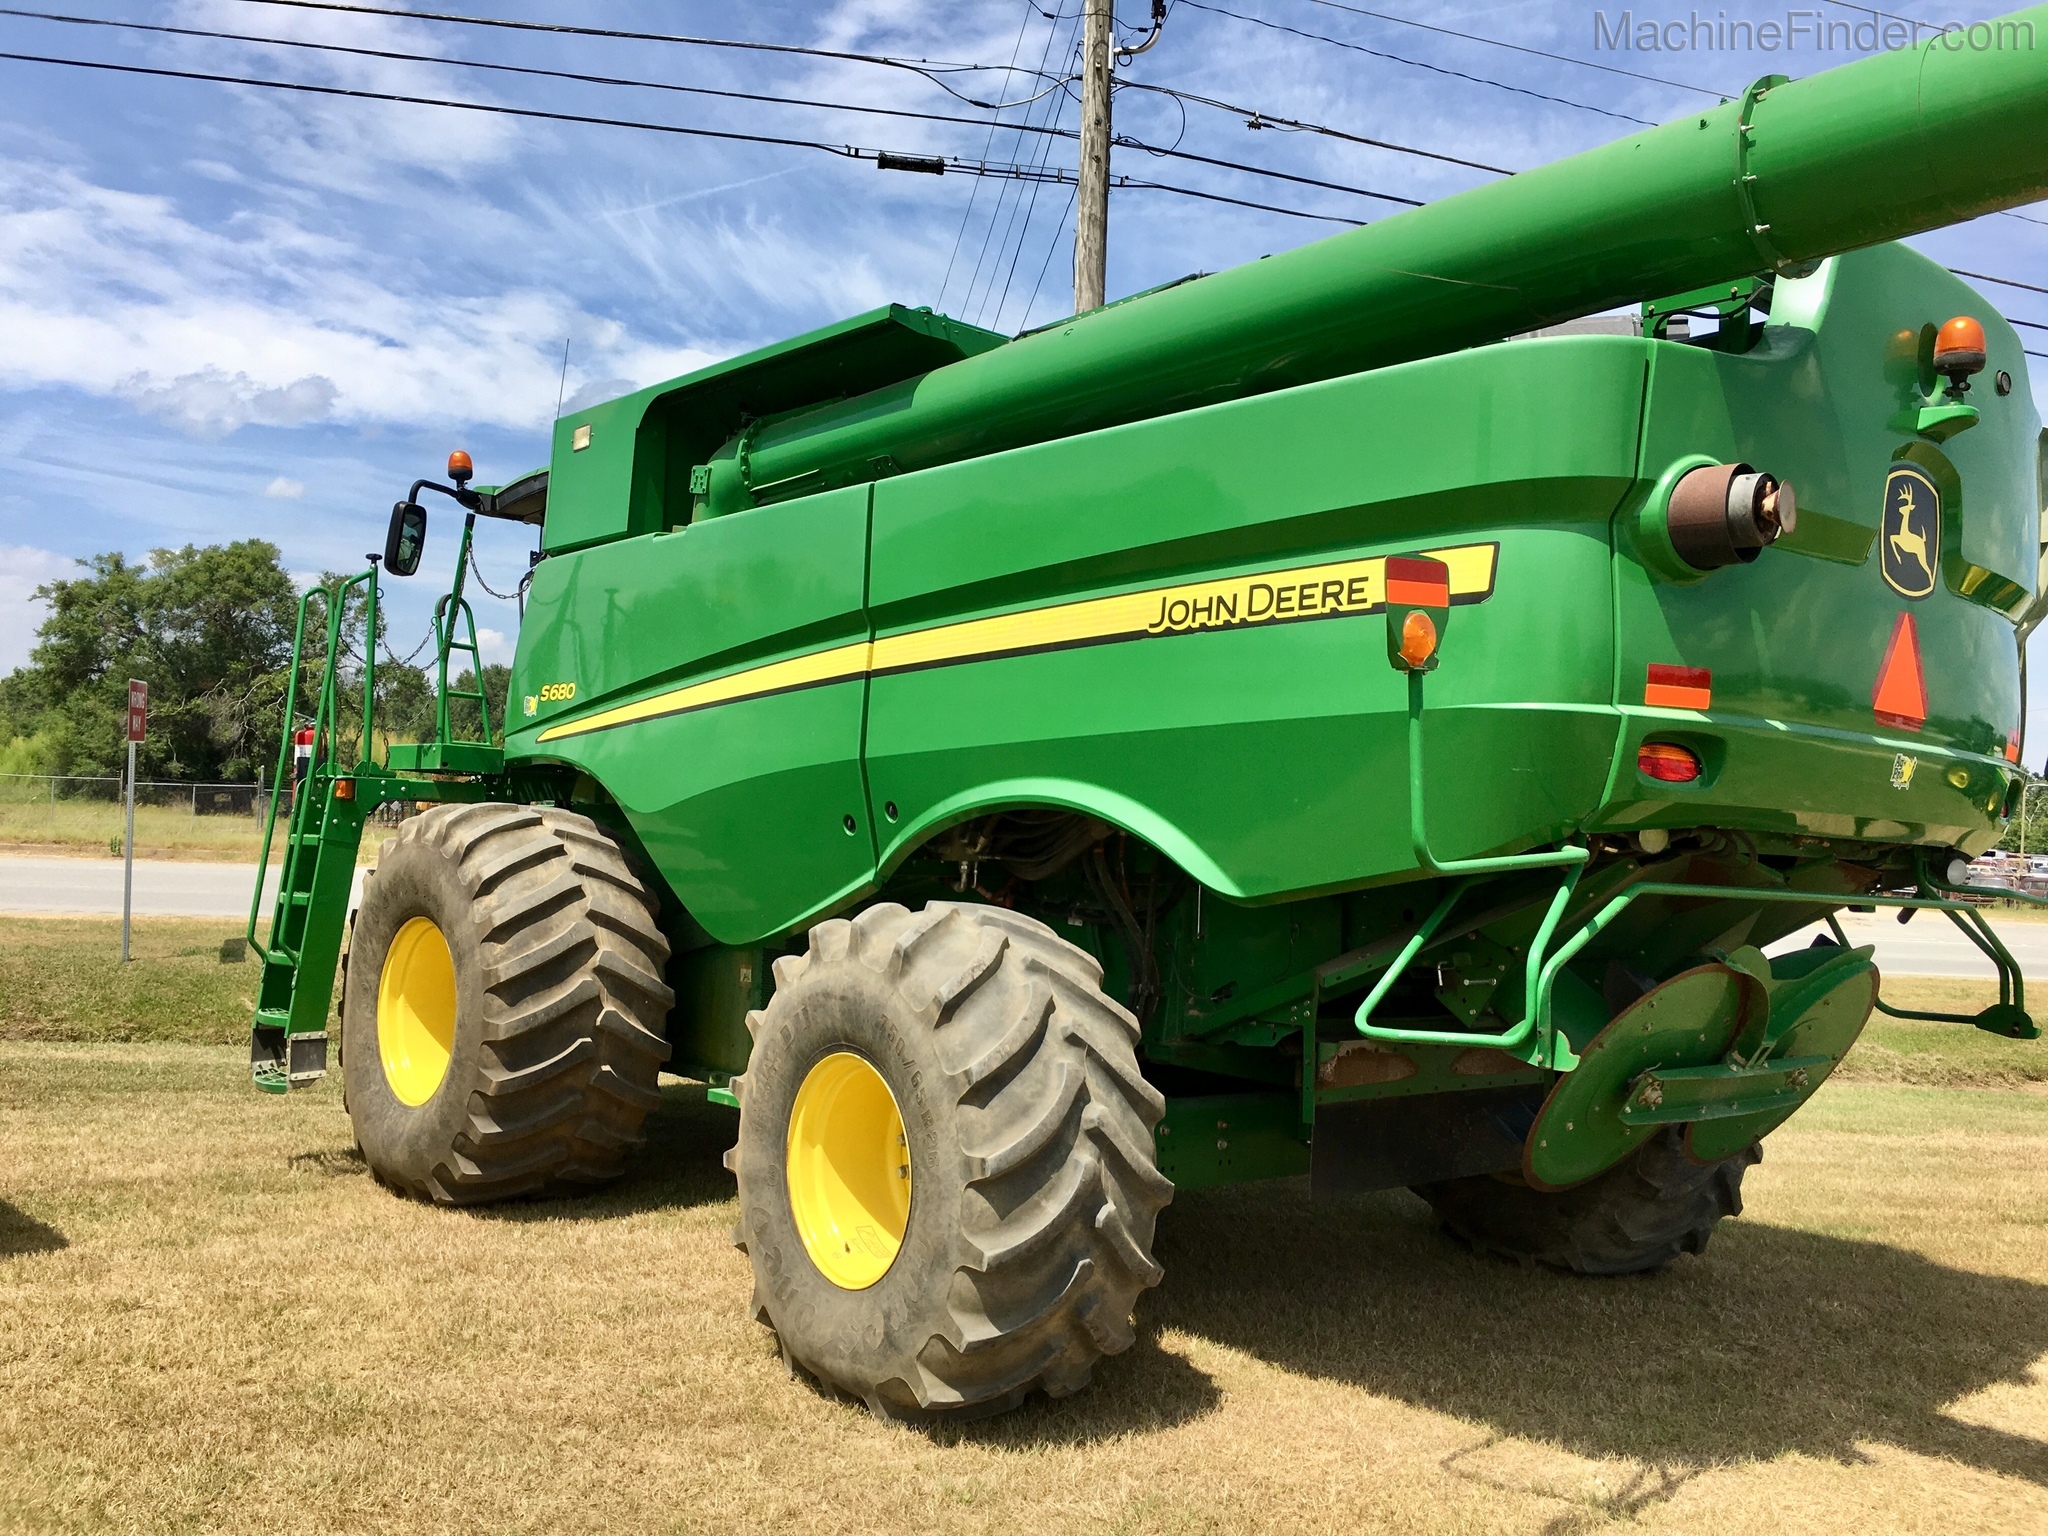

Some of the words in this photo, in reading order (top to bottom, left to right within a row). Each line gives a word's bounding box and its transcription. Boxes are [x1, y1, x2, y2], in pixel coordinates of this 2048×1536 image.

[1149, 593, 1238, 629] JOHN
[1249, 576, 1369, 614] DEERE
[131, 691, 145, 709] WRONG
[540, 682, 576, 702] S680
